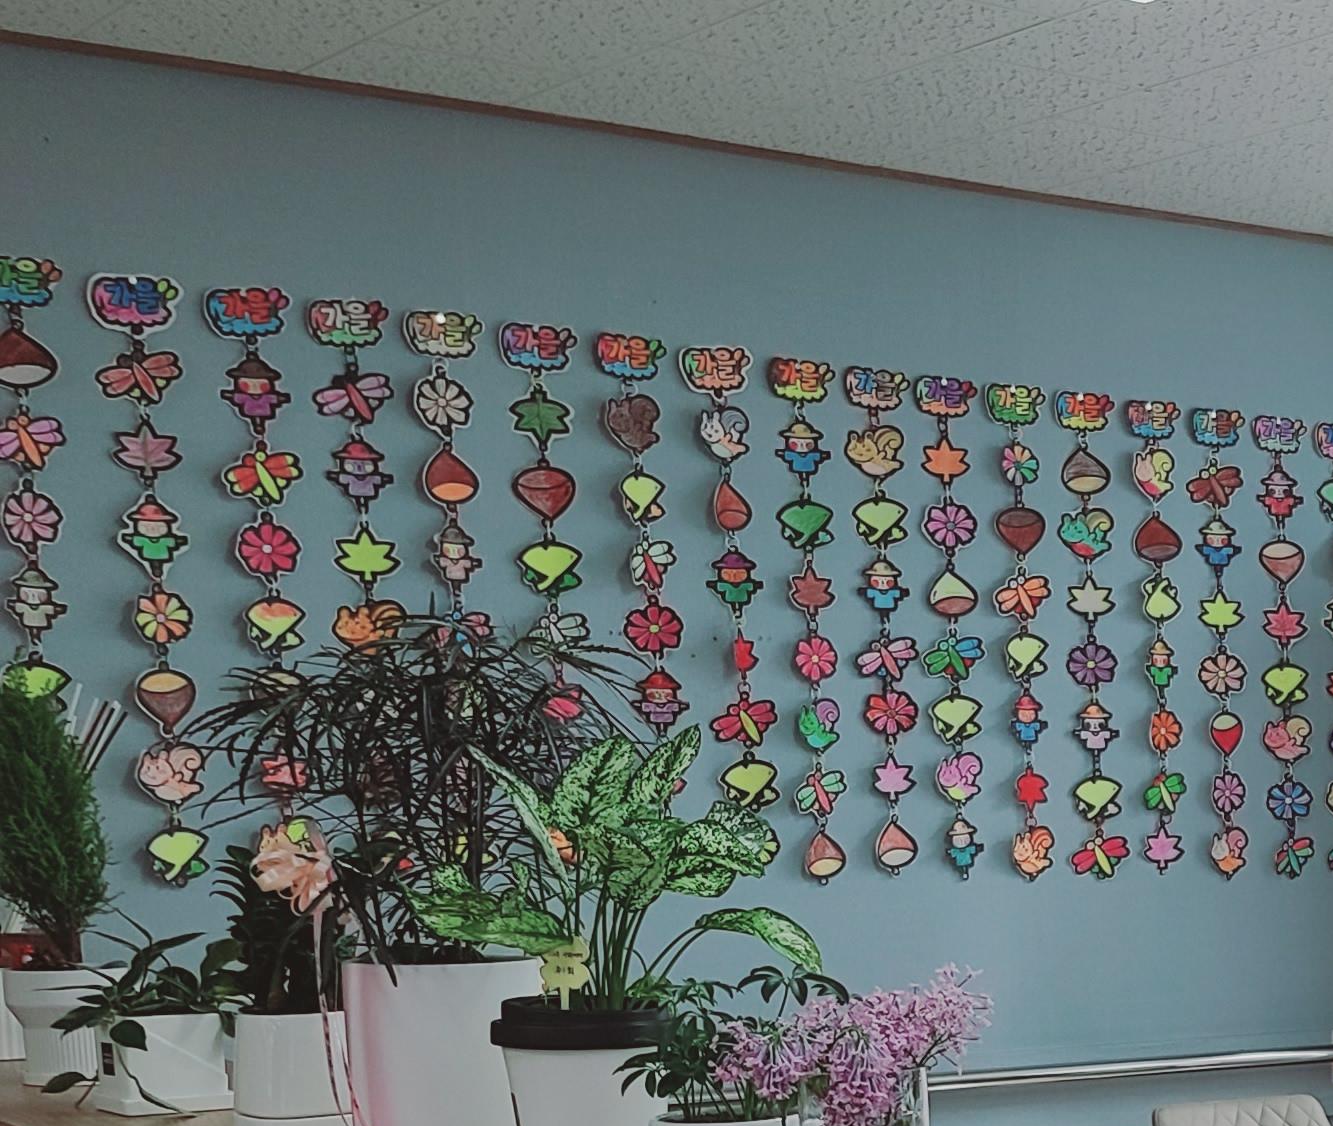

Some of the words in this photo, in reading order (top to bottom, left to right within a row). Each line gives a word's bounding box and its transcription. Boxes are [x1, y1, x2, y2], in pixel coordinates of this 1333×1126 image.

[104, 279, 163, 314] 가을
[218, 288, 272, 324] 가을
[320, 301, 372, 335] 가을
[415, 313, 468, 347] 가을
[511, 326, 562, 359] 가을
[603, 336, 652, 368] 가을
[693, 347, 738, 380] 가을
[777, 360, 820, 393] 가을
[854, 369, 897, 401] 가을
[925, 377, 966, 409] 가을
[995, 385, 1034, 416] 가을
[1067, 392, 1102, 422] 가을
